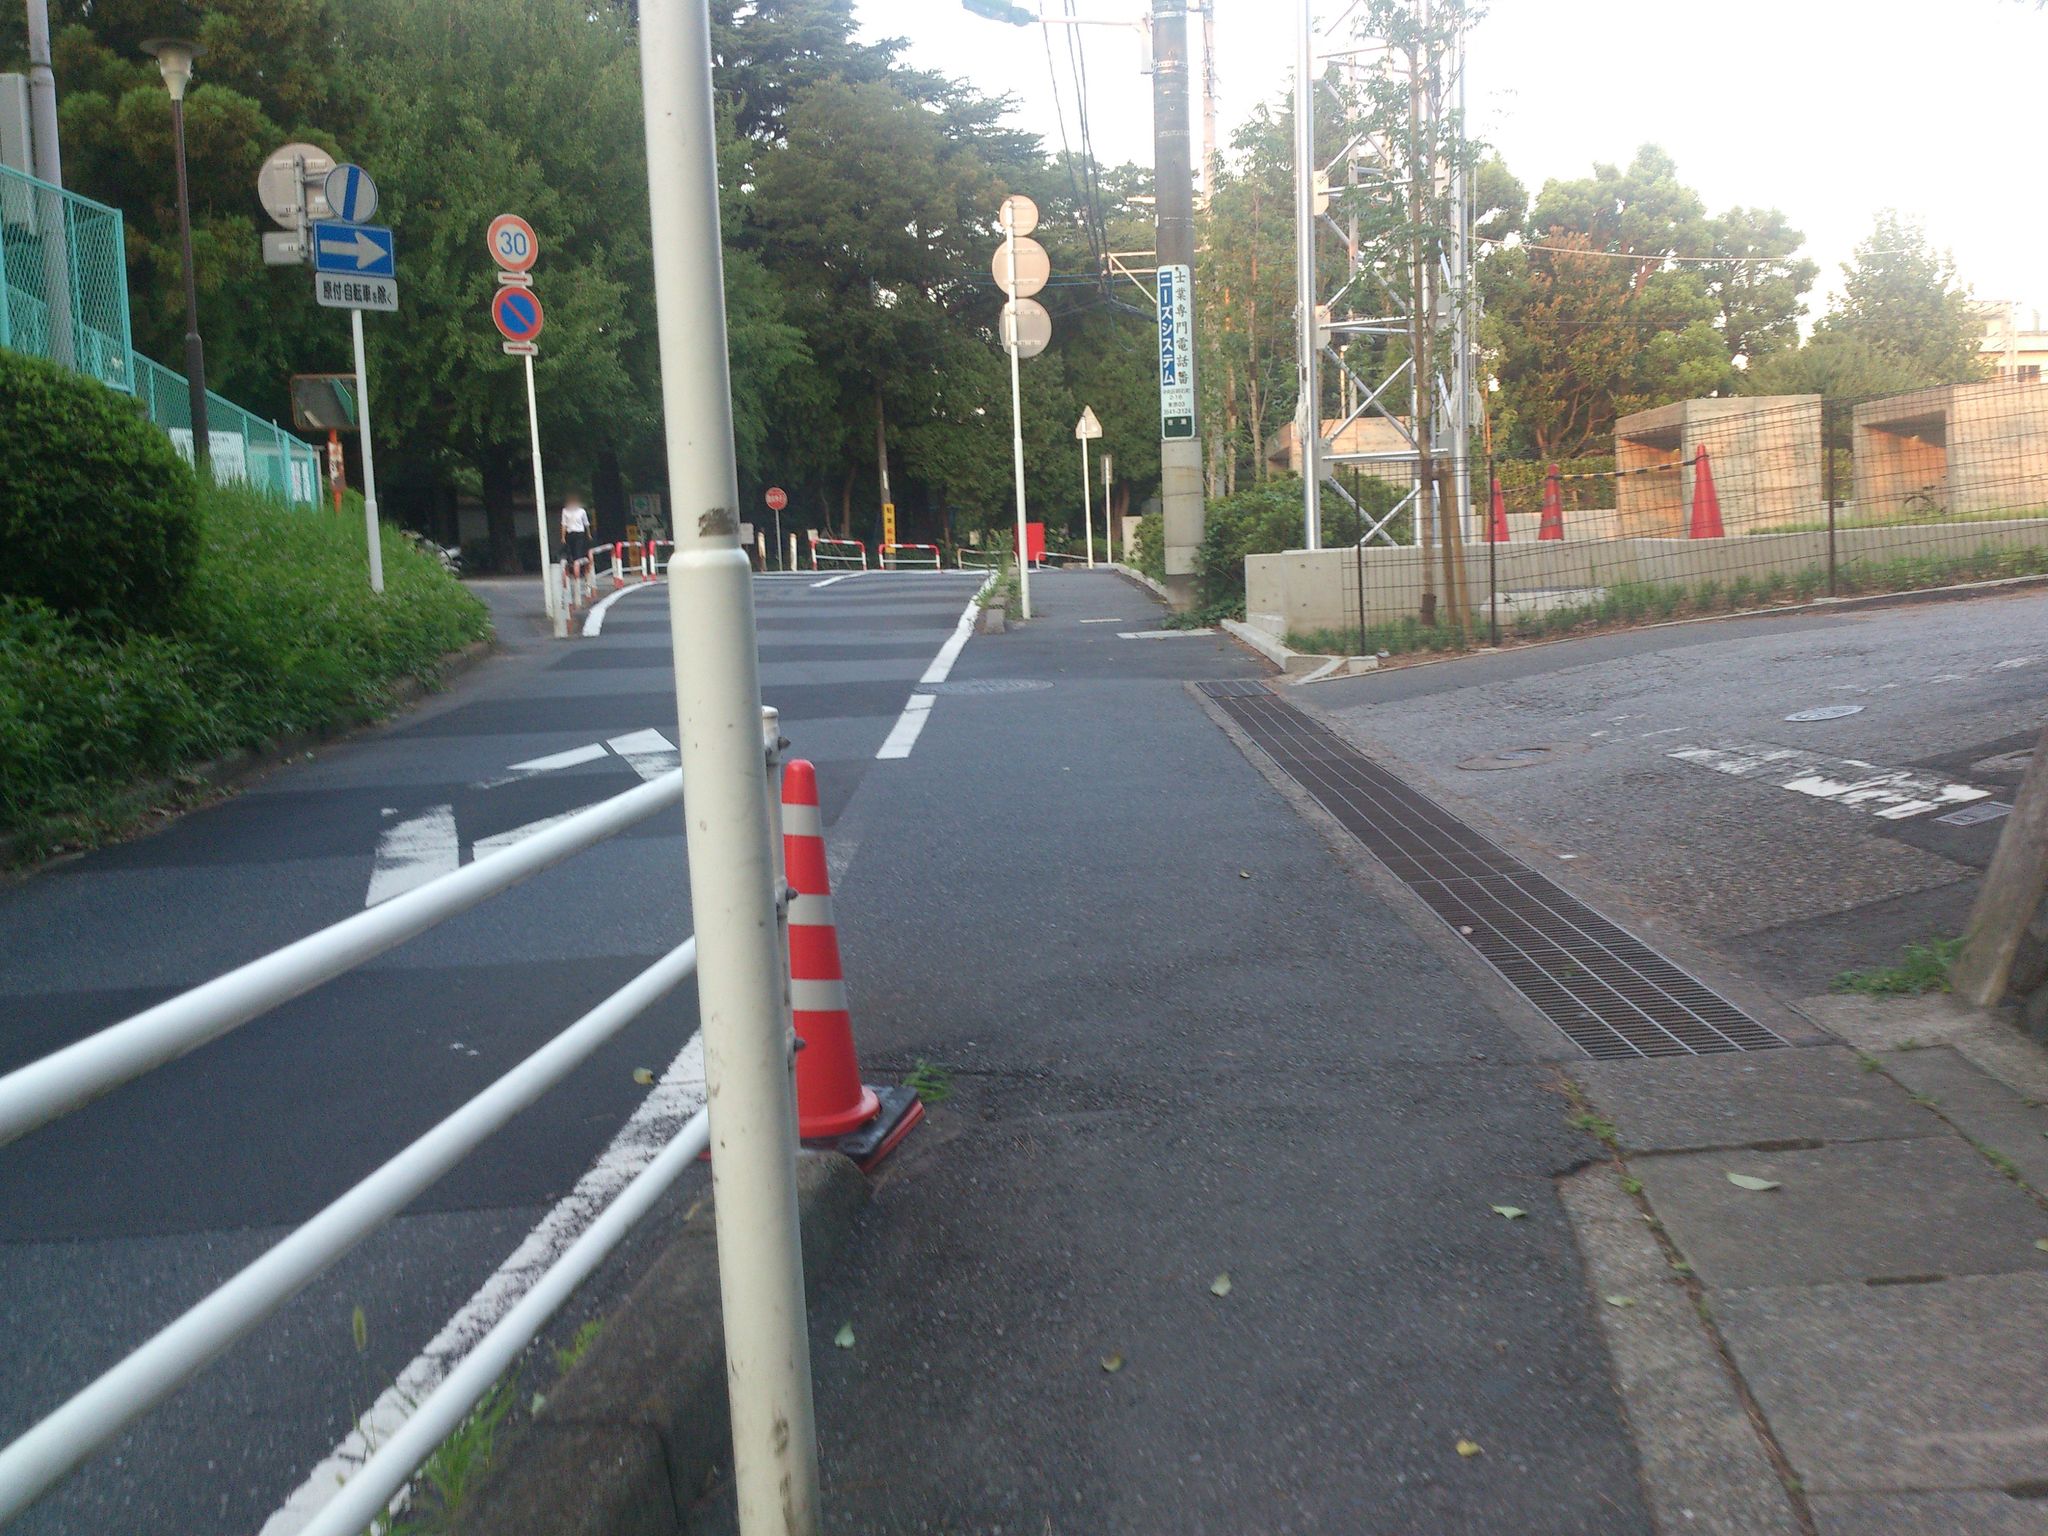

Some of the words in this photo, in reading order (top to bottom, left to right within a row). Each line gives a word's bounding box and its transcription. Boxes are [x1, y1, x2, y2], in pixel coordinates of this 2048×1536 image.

[500, 231, 527, 256] 30
[1160, 273, 1176, 384] ニーズシステム
